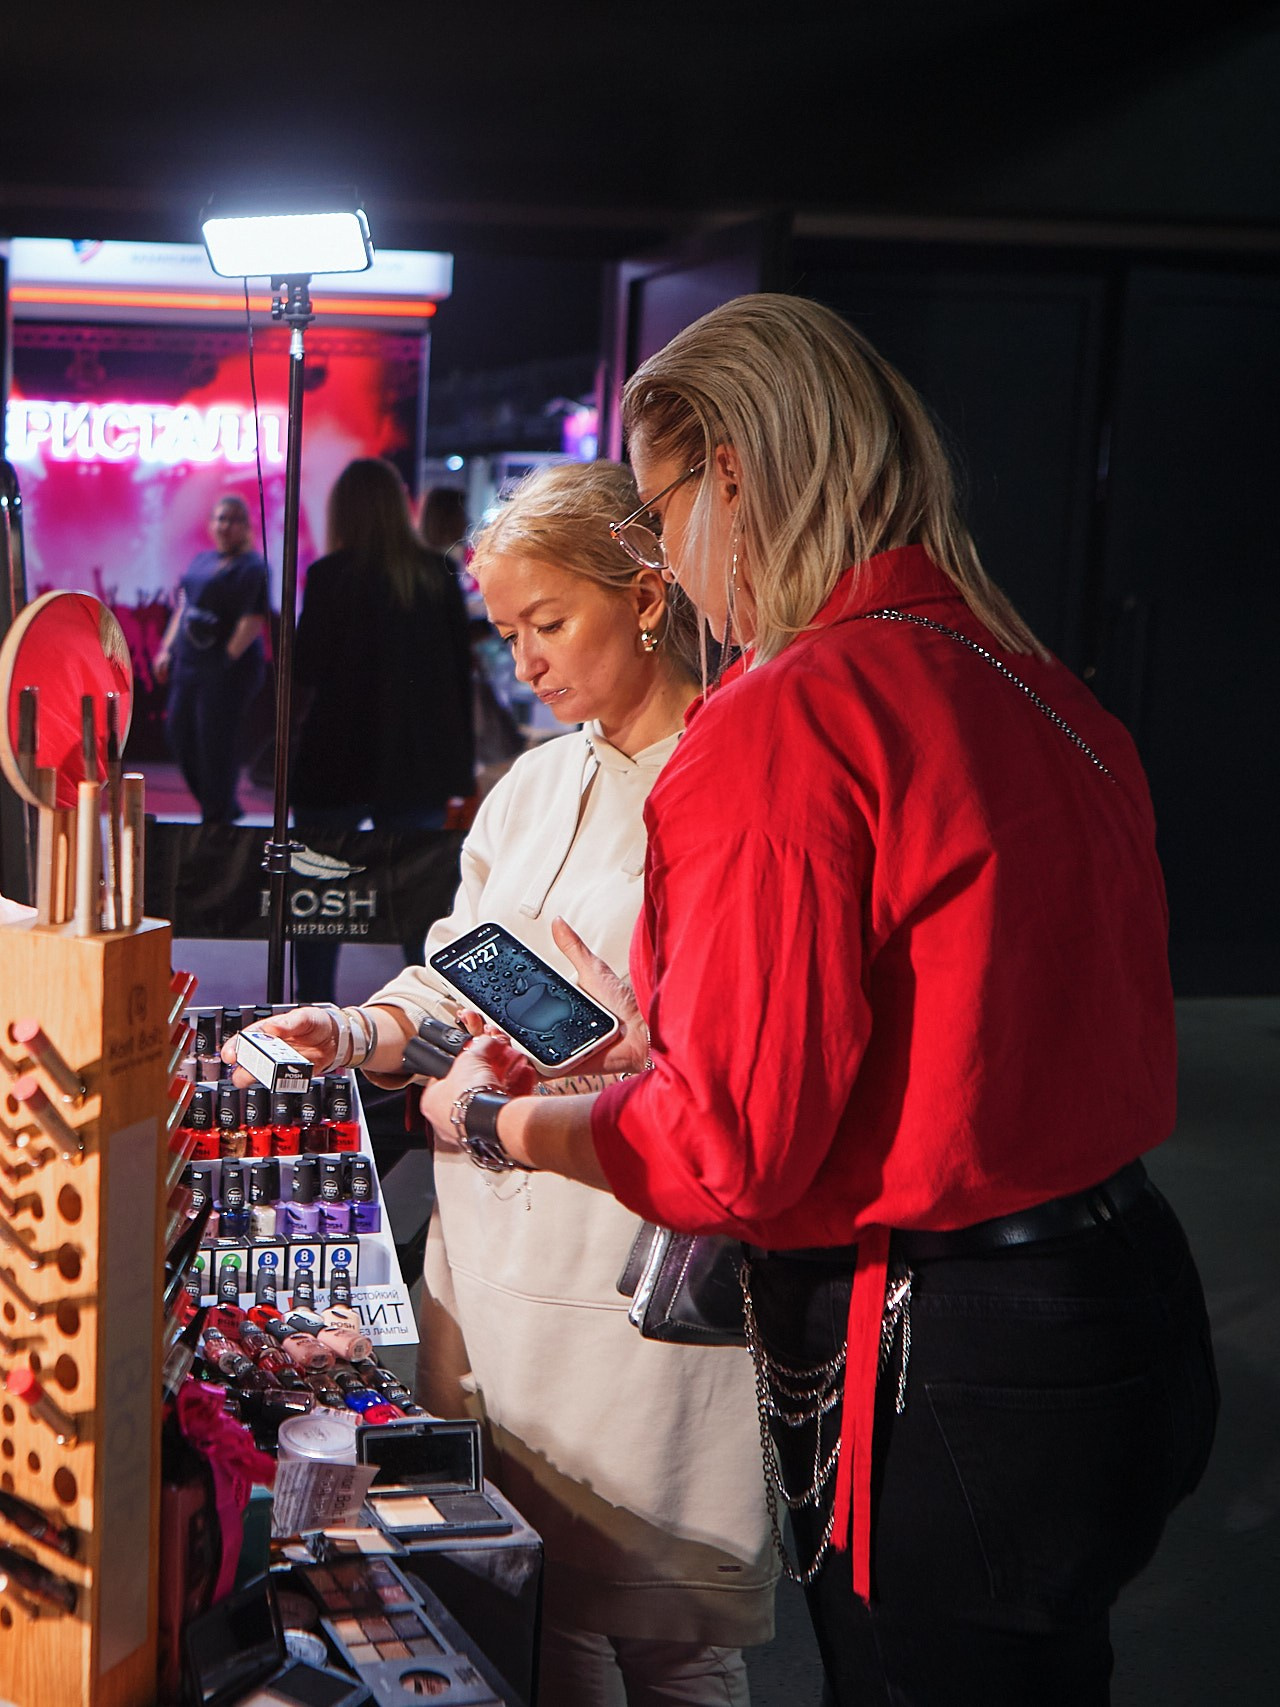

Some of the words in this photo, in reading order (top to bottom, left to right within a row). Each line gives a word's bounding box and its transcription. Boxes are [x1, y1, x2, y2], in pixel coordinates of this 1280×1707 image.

[458, 943, 499, 973] 17:27
[264, 1253, 272, 1264] 8
[300, 1250, 308, 1261] 8
[337, 1249, 345, 1260] 8
[330, 1321, 355, 1329] POSH
[373, 1326, 408, 1335] ЛАМПЫ
